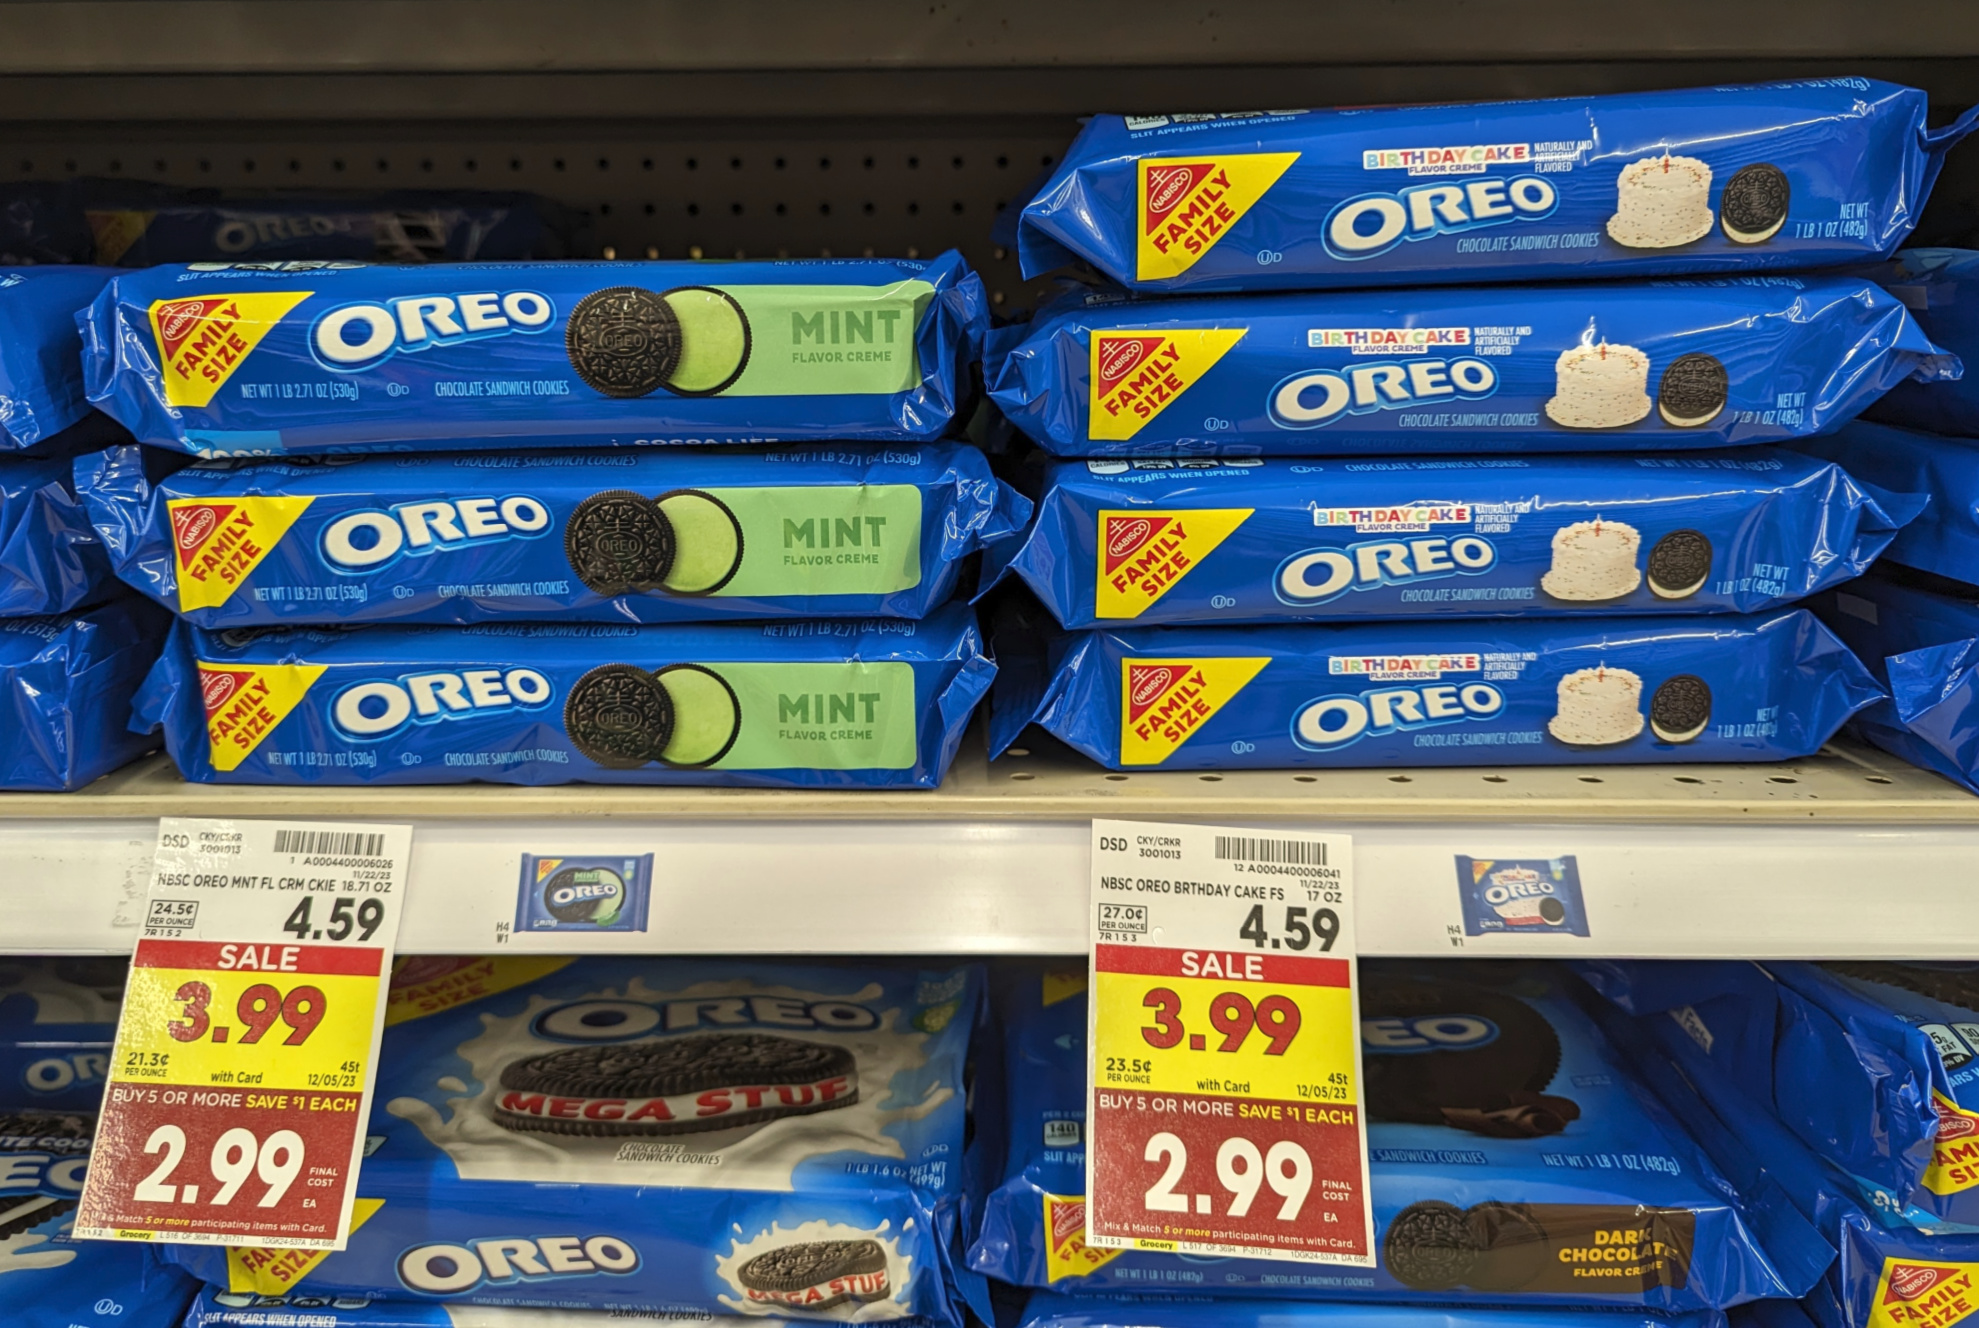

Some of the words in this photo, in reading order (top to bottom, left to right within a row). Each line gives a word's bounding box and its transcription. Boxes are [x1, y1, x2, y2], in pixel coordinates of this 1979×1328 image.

[1366, 148, 1466, 168] BIRTHDAY
[1472, 145, 1526, 162] CAKE
[1409, 165, 1447, 175] FLAVOR
[1449, 163, 1483, 172] CREME
[1153, 172, 1189, 210] NABISCO
[1153, 169, 1231, 254] FAMILY
[1330, 178, 1554, 250] OREO
[1184, 201, 1236, 255] SIZE
[1457, 237, 1508, 253] CHOCOLATE
[1510, 235, 1558, 251] SANDWICH
[1560, 233, 1599, 248] COOKIES
[165, 303, 200, 337] NABISCO
[317, 292, 550, 362] OREO
[792, 310, 901, 345] MINT
[175, 303, 244, 380] FAMILY
[604, 334, 642, 348] OREO
[1311, 331, 1409, 345] BIRTHDAY
[1413, 330, 1466, 344] CAKE
[202, 332, 248, 384] SIZE
[792, 352, 843, 363] FLAVOR
[847, 351, 892, 362] CREME
[241, 384, 258, 398] NET
[259, 384, 272, 398] WT
[275, 384, 279, 398] 1
[282, 384, 292, 398] LB
[295, 384, 314, 398] 2.71
[316, 384, 329, 398] OZ
[329, 380, 359, 400] (530g)
[435, 381, 484, 397] CHOCOLATE
[486, 381, 531, 396] SANDWICH
[533, 380, 569, 395] COOKIES
[1104, 342, 1181, 417] FAMILY
[1134, 372, 1184, 419] SIZE
[1275, 360, 1494, 421] OREO
[1317, 510, 1411, 525] BIRTHDAY
[1416, 508, 1467, 521] CAKE
[325, 497, 548, 566] OREO
[783, 516, 886, 549] MINT
[191, 510, 255, 582] FAMILY
[220, 539, 262, 584] SIZE
[784, 555, 833, 566] FLAVOR
[836, 554, 879, 564] CREME
[1111, 522, 1188, 594] FAMILY
[1281, 538, 1493, 598] OREO
[1141, 551, 1191, 597] SIZE
[1332, 659, 1422, 673] BIRTHDAY
[1427, 656, 1476, 669] CAKE
[336, 669, 550, 733] OREO
[778, 693, 880, 724] MINT
[1135, 670, 1207, 742] FAMILY
[209, 678, 271, 747] FAMILY
[1164, 698, 1211, 743] SIZE
[1298, 684, 1501, 743] OREO
[234, 706, 277, 750] SIZE
[779, 730, 827, 741] FLAVOR
[830, 729, 872, 740] CREME
[163, 835, 189, 848] DSD
[1100, 837, 1127, 851] DSD
[1137, 836, 1181, 847] CKY/CRKR
[304, 857, 393, 869] A0004400006026
[1139, 849, 1181, 859] 3001013
[353, 870, 391, 880] 11/22/23
[1234, 864, 1243, 872] 12
[1248, 864, 1341, 878] A0004400006041
[158, 873, 190, 886] NBSC
[194, 875, 228, 887] OREO
[231, 877, 258, 889] MNT
[261, 878, 274, 889] FL
[278, 878, 304, 890] CRM
[308, 879, 336, 891] CKIE
[342, 882, 370, 892] 18.71
[374, 882, 392, 893] OZ
[1101, 877, 1132, 890] NBSC
[1136, 879, 1170, 893] OREO
[1175, 882, 1231, 897] BRTHDAY
[1234, 885, 1266, 899] CAKE
[1270, 888, 1284, 900] FS
[1300, 880, 1340, 890] 11/22/23
[1485, 882, 1554, 904] OREO
[553, 885, 616, 903] OREO
[1307, 891, 1319, 901] 17
[1323, 892, 1342, 903] OZ
[154, 902, 194, 915] 24.5¢
[283, 896, 385, 941] 4.59
[1103, 907, 1143, 920] 27.0¢
[150, 917, 165, 925] PER
[166, 918, 193, 926] OUNCE
[1118, 922, 1145, 931] OUNCE
[1239, 904, 1340, 952] 4.59
[217, 945, 301, 971] SALE
[1181, 951, 1264, 980] SALE
[167, 980, 327, 1046] 3.99
[544, 998, 874, 1038] OREO
[1141, 987, 1301, 1056] 3.99
[126, 1052, 170, 1066] 21.3¢
[340, 1061, 360, 1073] 45t
[1106, 1058, 1152, 1072] 23.5¢
[211, 1071, 234, 1082] with
[236, 1072, 263, 1084] Card
[308, 1074, 356, 1087] 12/05/23
[1107, 1073, 1122, 1082] PER
[1124, 1074, 1150, 1084] OUNCE
[1197, 1079, 1221, 1091] with
[1224, 1080, 1250, 1093] Card
[1328, 1073, 1348, 1085] 45t
[112, 1088, 148, 1102] BUY
[148, 1090, 158, 1103] 5
[163, 1091, 188, 1104] OR
[192, 1093, 242, 1107] MORE
[246, 1095, 287, 1109] SAVE
[293, 1095, 305, 1110] $1
[312, 1097, 357, 1112] EACH
[502, 1092, 676, 1122] MEGA
[696, 1076, 848, 1118] STUF
[1297, 1085, 1347, 1099] 12/05/23
[1099, 1094, 1133, 1109] BUY
[1137, 1097, 1146, 1110] 5
[1152, 1098, 1177, 1112] OR
[1183, 1101, 1234, 1117] MORE
[1239, 1104, 1282, 1120] SAVE
[1287, 1107, 1300, 1121] $1
[1306, 1109, 1354, 1125] EACH
[133, 1124, 305, 1208] 2.99
[1378, 1150, 1436, 1164] SANDWICH
[1438, 1151, 1486, 1165] COOKIES
[309, 1167, 338, 1176] FINAL
[1144, 1131, 1313, 1221] 2.99
[307, 1178, 334, 1187] COST
[1322, 1180, 1352, 1190] FINAL
[303, 1199, 317, 1209] EA
[1323, 1191, 1349, 1201] COST
[1324, 1213, 1338, 1222] EA
[1104, 1222, 1121, 1233] Mix
[1123, 1223, 1129, 1232] &
[1132, 1224, 1161, 1234] Match
[1164, 1226, 1170, 1234] 5
[1172, 1227, 1183, 1235] or
[1185, 1228, 1210, 1237] more
[1213, 1229, 1275, 1244] participating
[1278, 1235, 1304, 1245] items
[1306, 1237, 1328, 1247] with
[1329, 1238, 1356, 1249] Card.
[1140, 1240, 1173, 1250] Grocery
[1595, 1228, 1652, 1245] DARK
[1243, 1247, 1272, 1256] P-31712
[402, 1236, 636, 1290] OREO
[748, 1286, 823, 1304] MEGA
[829, 1272, 886, 1295] STUF
[1888, 1274, 1972, 1323] FAMILY
